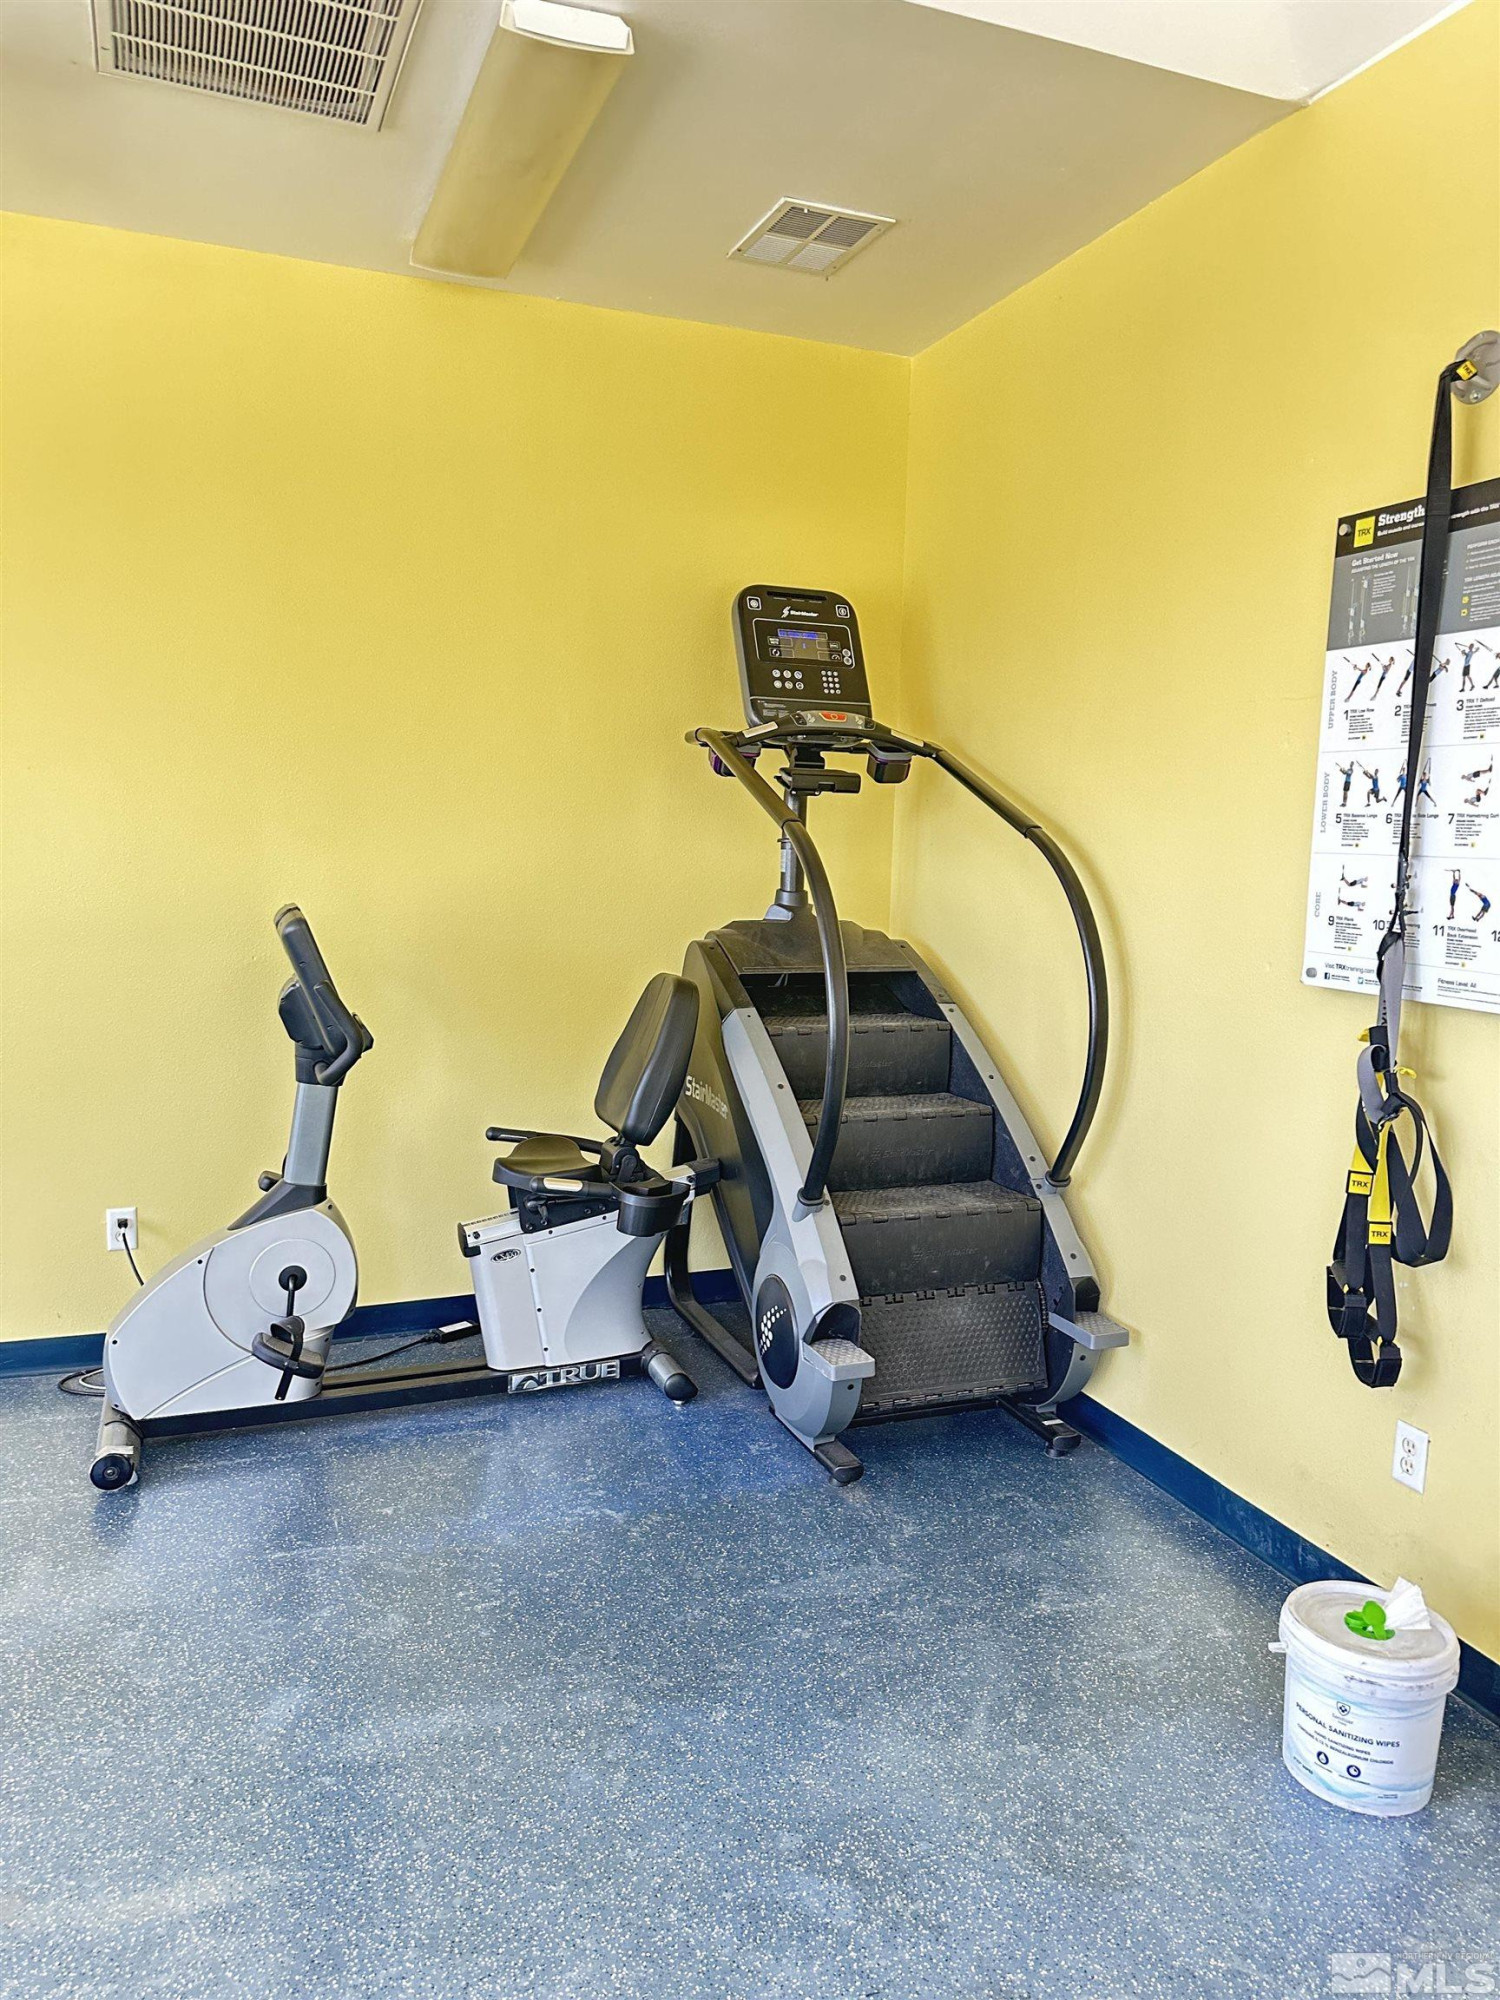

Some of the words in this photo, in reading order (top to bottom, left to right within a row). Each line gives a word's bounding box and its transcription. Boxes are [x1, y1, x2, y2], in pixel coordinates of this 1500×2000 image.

[1378, 504, 1425, 526] Strength
[1358, 527, 1371, 537] TRX
[1363, 554, 1384, 564] Started
[1394, 705, 1401, 716] 2
[1456, 700, 1464, 711] 3
[1344, 710, 1349, 720] 1
[1320, 800, 1328, 833] LOWER
[1336, 813, 1342, 823] 5
[1386, 813, 1393, 824] 6
[1448, 813, 1455, 824] 7
[1328, 916, 1334, 926] 9
[1373, 920, 1385, 931] 10
[1433, 925, 1444, 936] 11
[685, 1075, 728, 1119] StairMaster
[541, 1362, 617, 1385] TRUE
[1296, 1702, 1327, 1729] PERSONAL
[1329, 1726, 1373, 1745] SANITIZING
